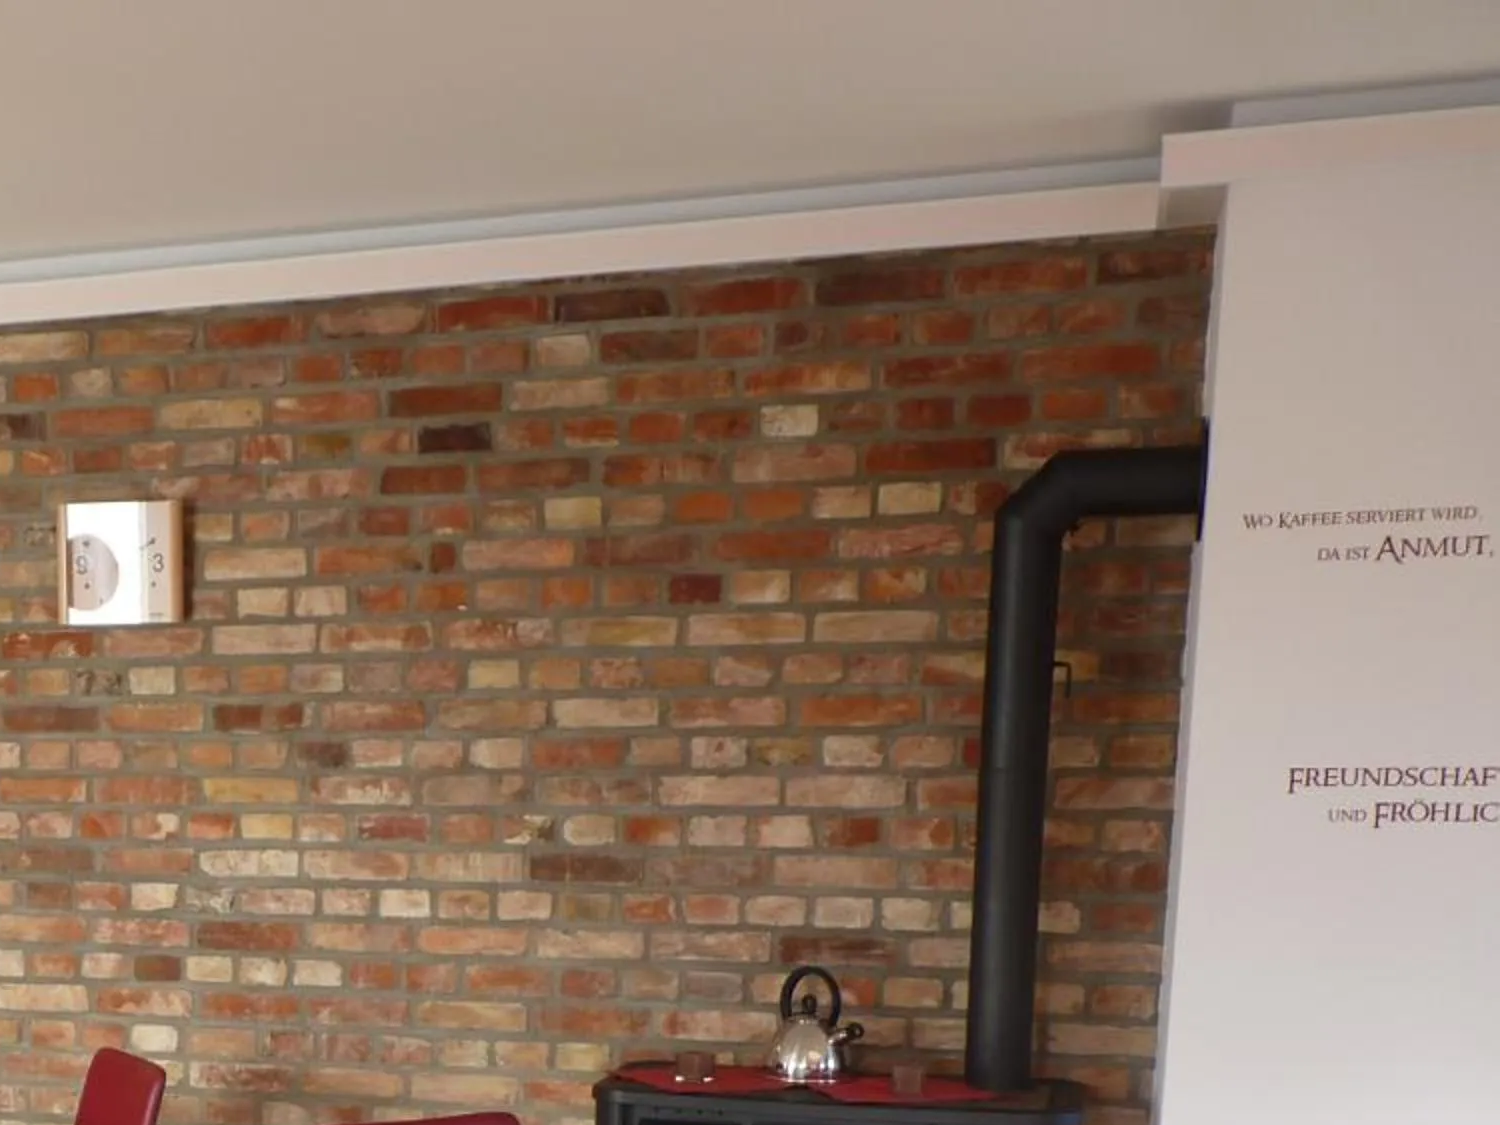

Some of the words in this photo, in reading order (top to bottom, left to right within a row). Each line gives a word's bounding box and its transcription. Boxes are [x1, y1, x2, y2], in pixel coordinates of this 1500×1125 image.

[1243, 512, 1274, 530] WO
[1279, 510, 1343, 529] KAFFEE
[1346, 507, 1427, 526] SERVIERT
[1317, 547, 1341, 562] DA
[1345, 547, 1371, 561] IST
[1374, 534, 1495, 565] ANMUT,
[1328, 808, 1368, 824] UND
